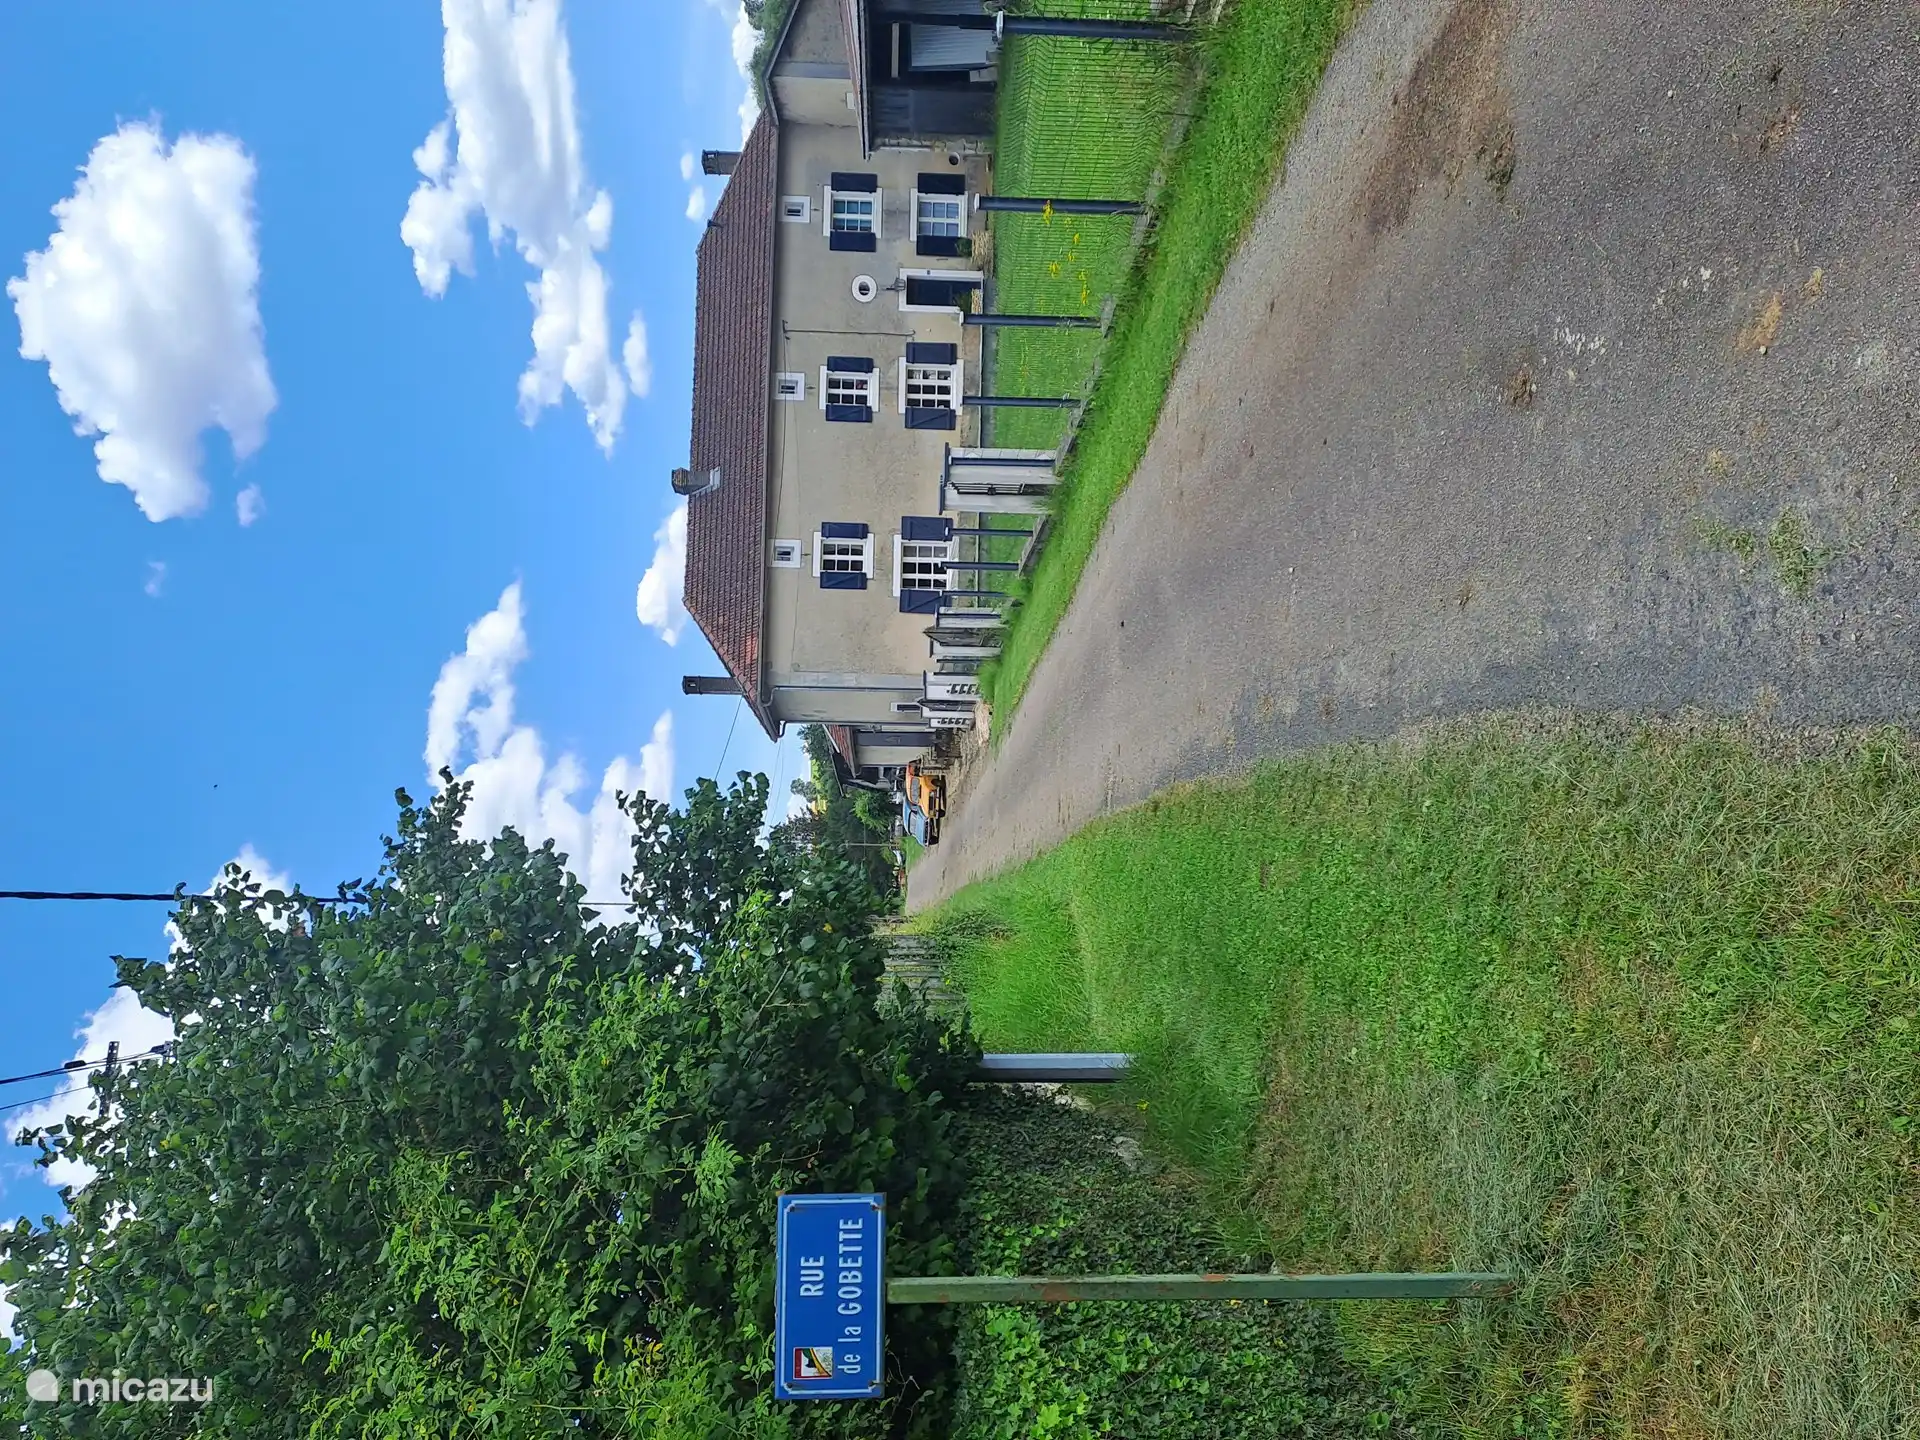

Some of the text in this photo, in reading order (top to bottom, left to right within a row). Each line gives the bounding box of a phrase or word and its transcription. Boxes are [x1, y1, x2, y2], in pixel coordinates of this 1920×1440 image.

[800, 1255, 824, 1296] RUE
[838, 1218, 863, 1374] de la GOBETTE
